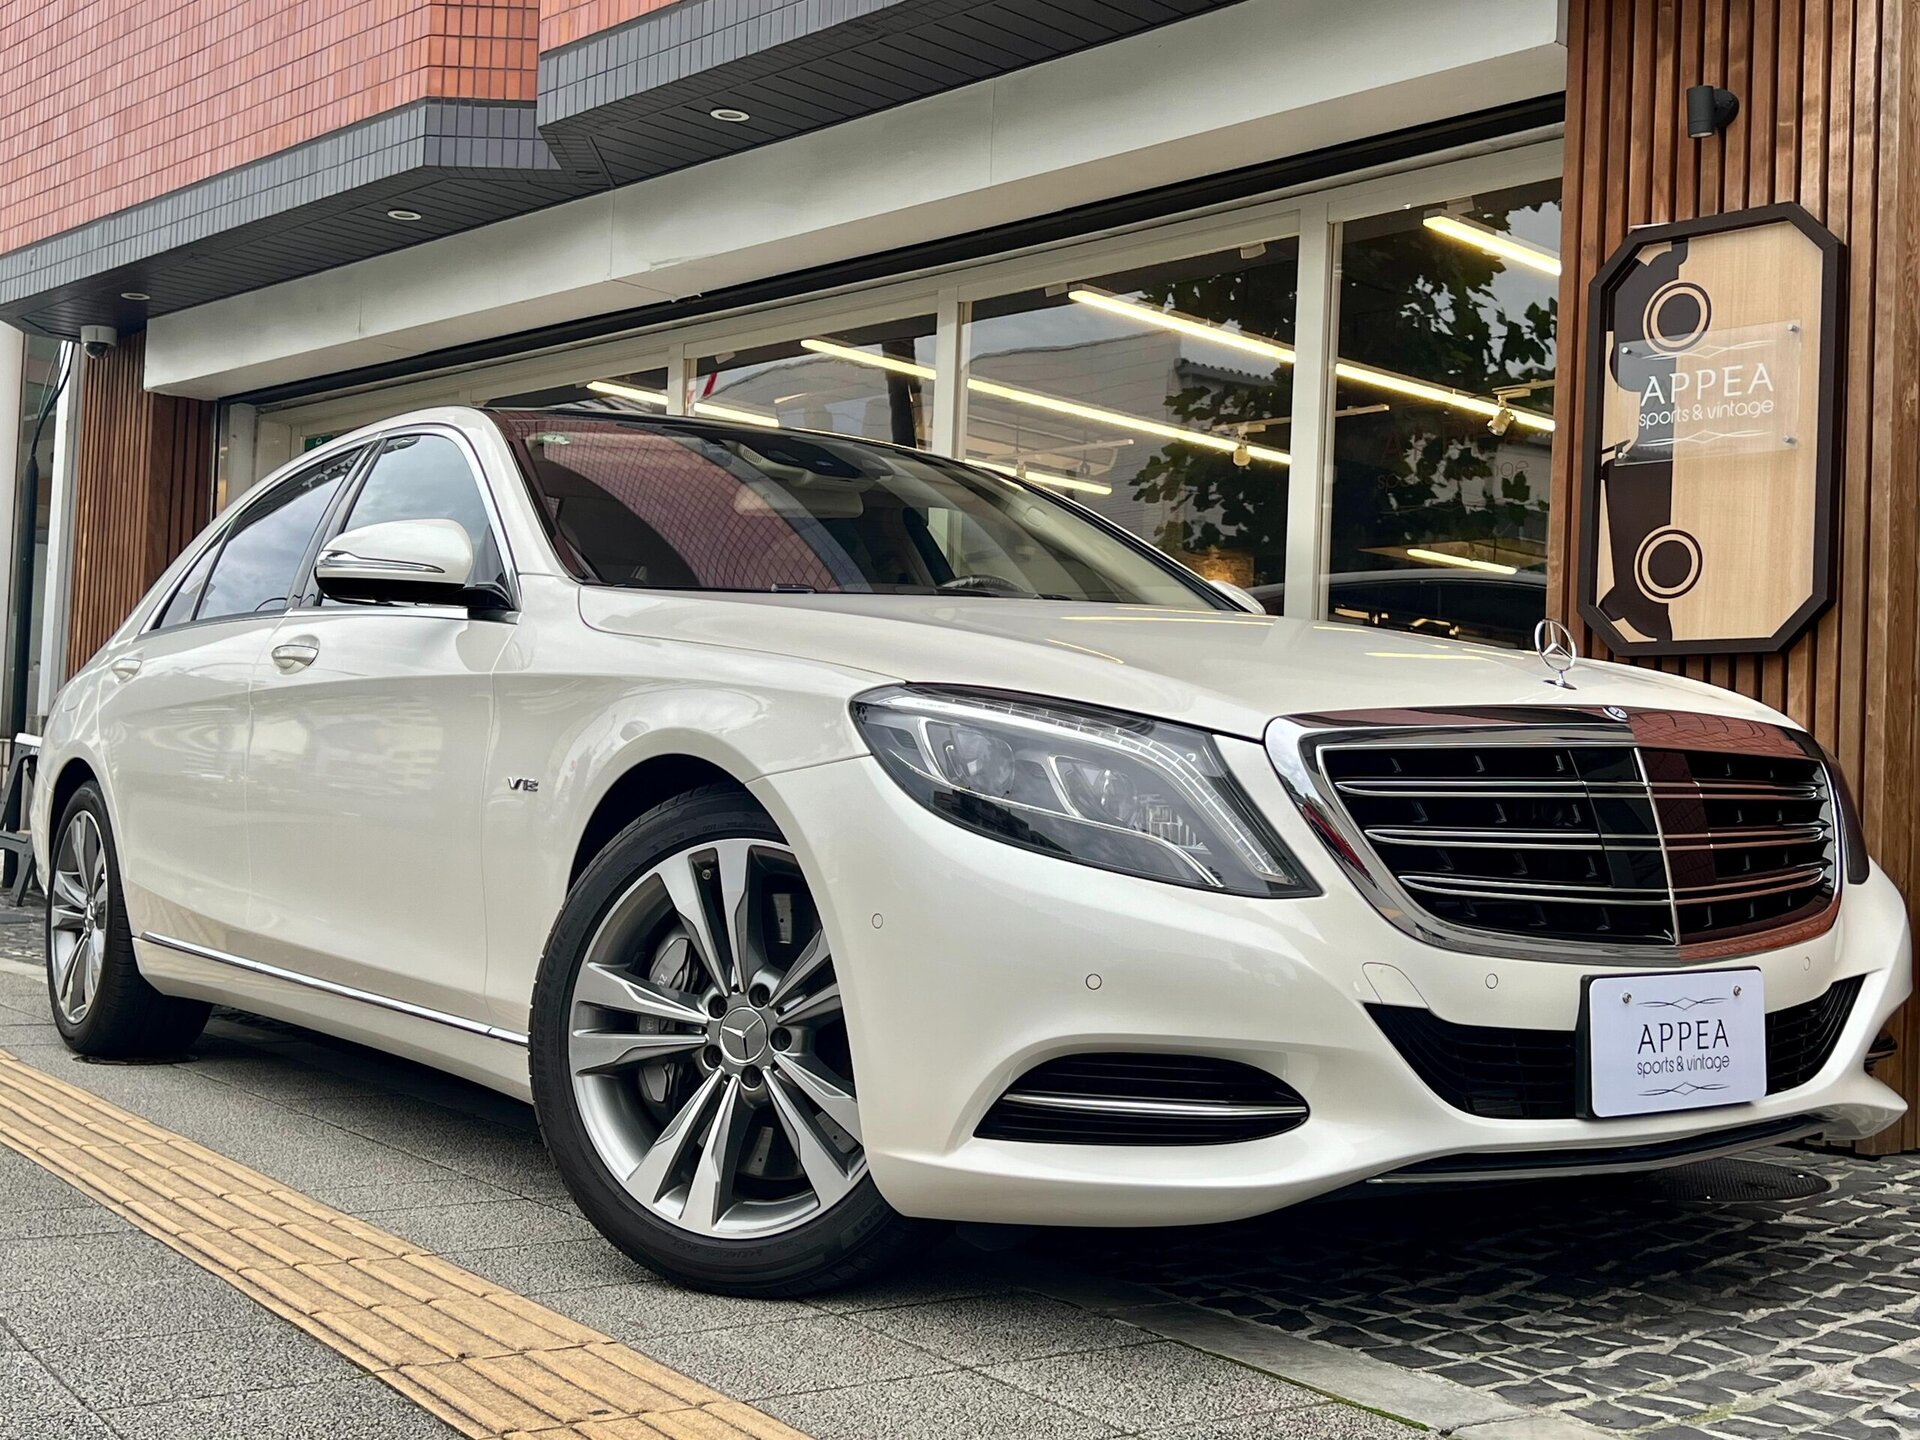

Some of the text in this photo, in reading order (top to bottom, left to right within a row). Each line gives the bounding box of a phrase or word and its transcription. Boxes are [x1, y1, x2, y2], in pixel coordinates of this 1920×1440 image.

[1640, 362, 1774, 407] APPEA
[1639, 399, 1774, 430] sports & vintage
[1637, 1018, 1730, 1054] APPEA
[1636, 1053, 1731, 1079] sports & vintage
